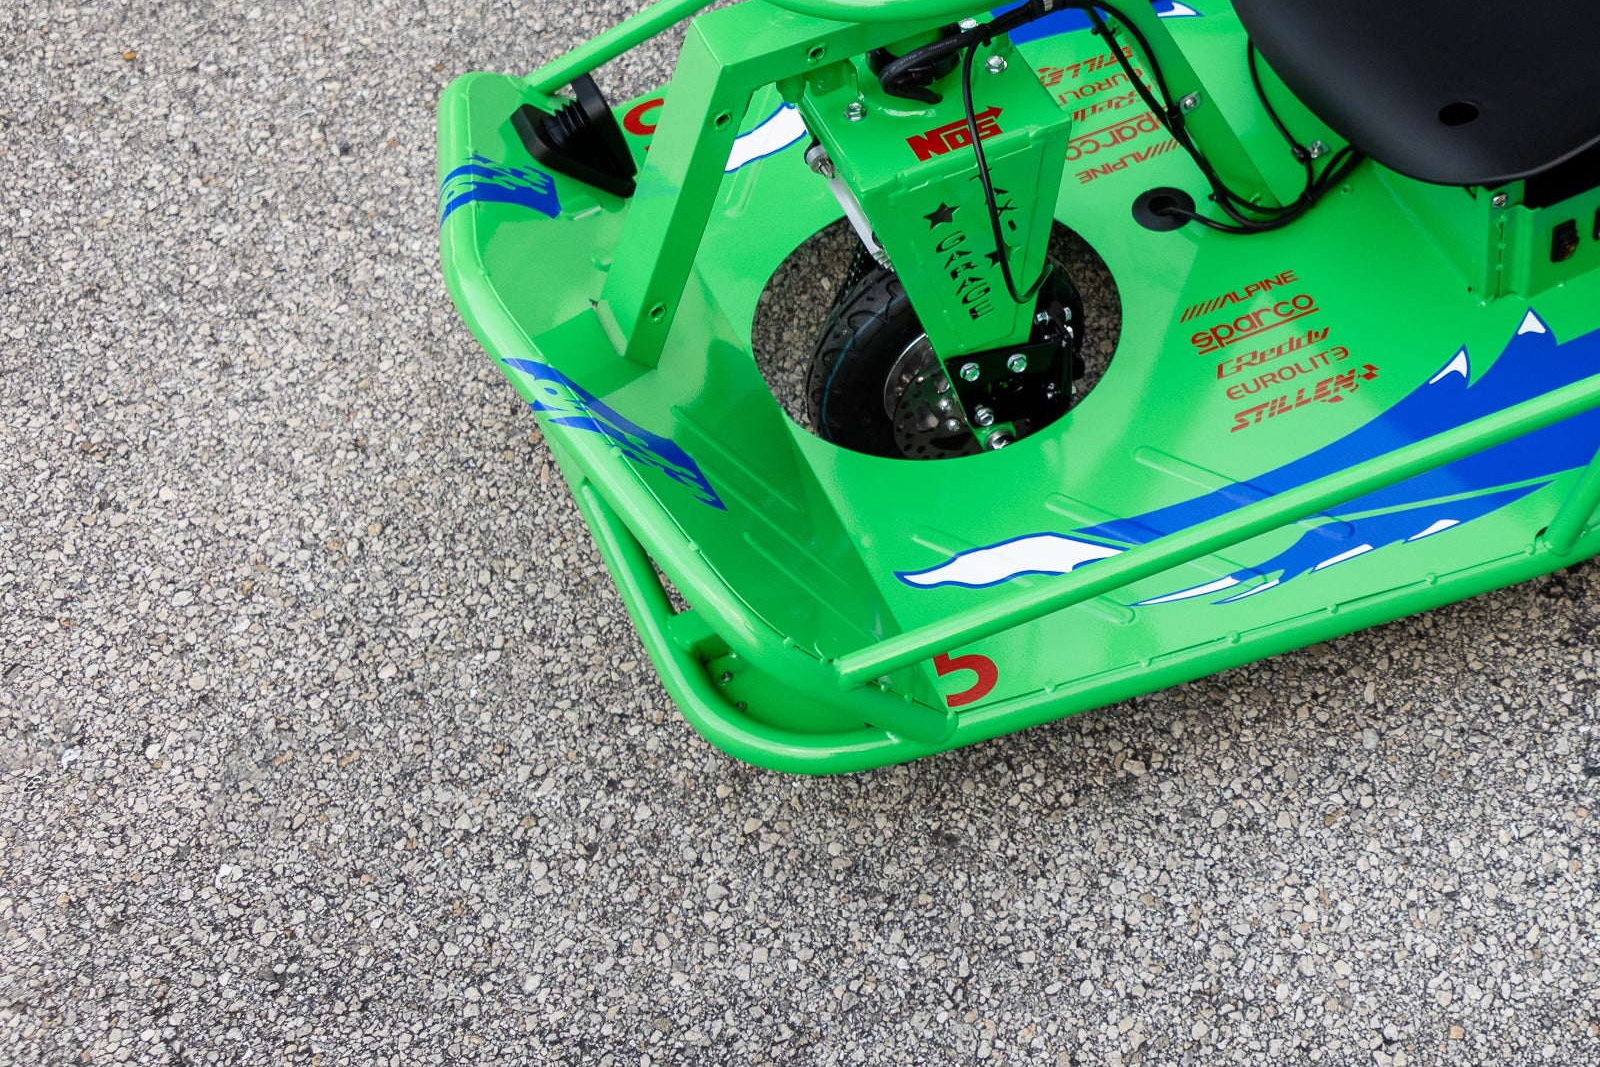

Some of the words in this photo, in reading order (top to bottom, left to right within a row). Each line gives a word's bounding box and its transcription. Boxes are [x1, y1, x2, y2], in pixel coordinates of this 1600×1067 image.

[905, 117, 1004, 162] NOS
[1065, 111, 1160, 161] parco
[935, 229, 995, 321] GARAGE
[1190, 294, 1315, 350] sparco
[1229, 368, 1359, 434] STILLEN
